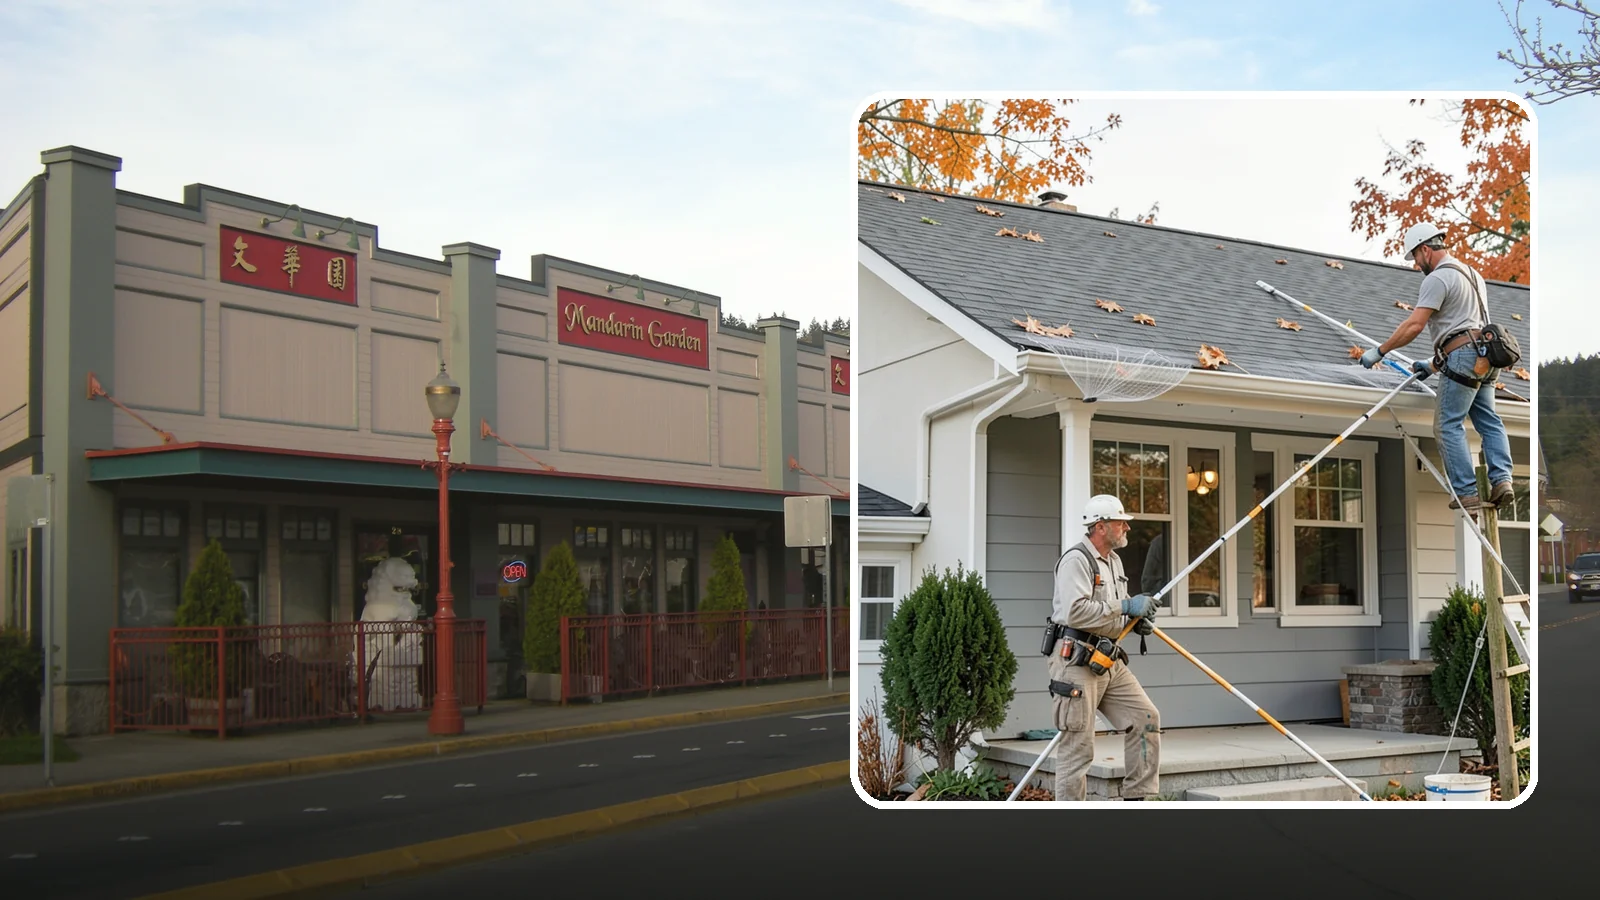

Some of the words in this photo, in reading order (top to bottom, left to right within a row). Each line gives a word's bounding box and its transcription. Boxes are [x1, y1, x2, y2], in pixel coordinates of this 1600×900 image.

[230, 235, 346, 291] 文華園
[564, 302, 644, 341] Mandarin
[648, 320, 701, 352] Garden
[503, 565, 526, 577] OPEN
